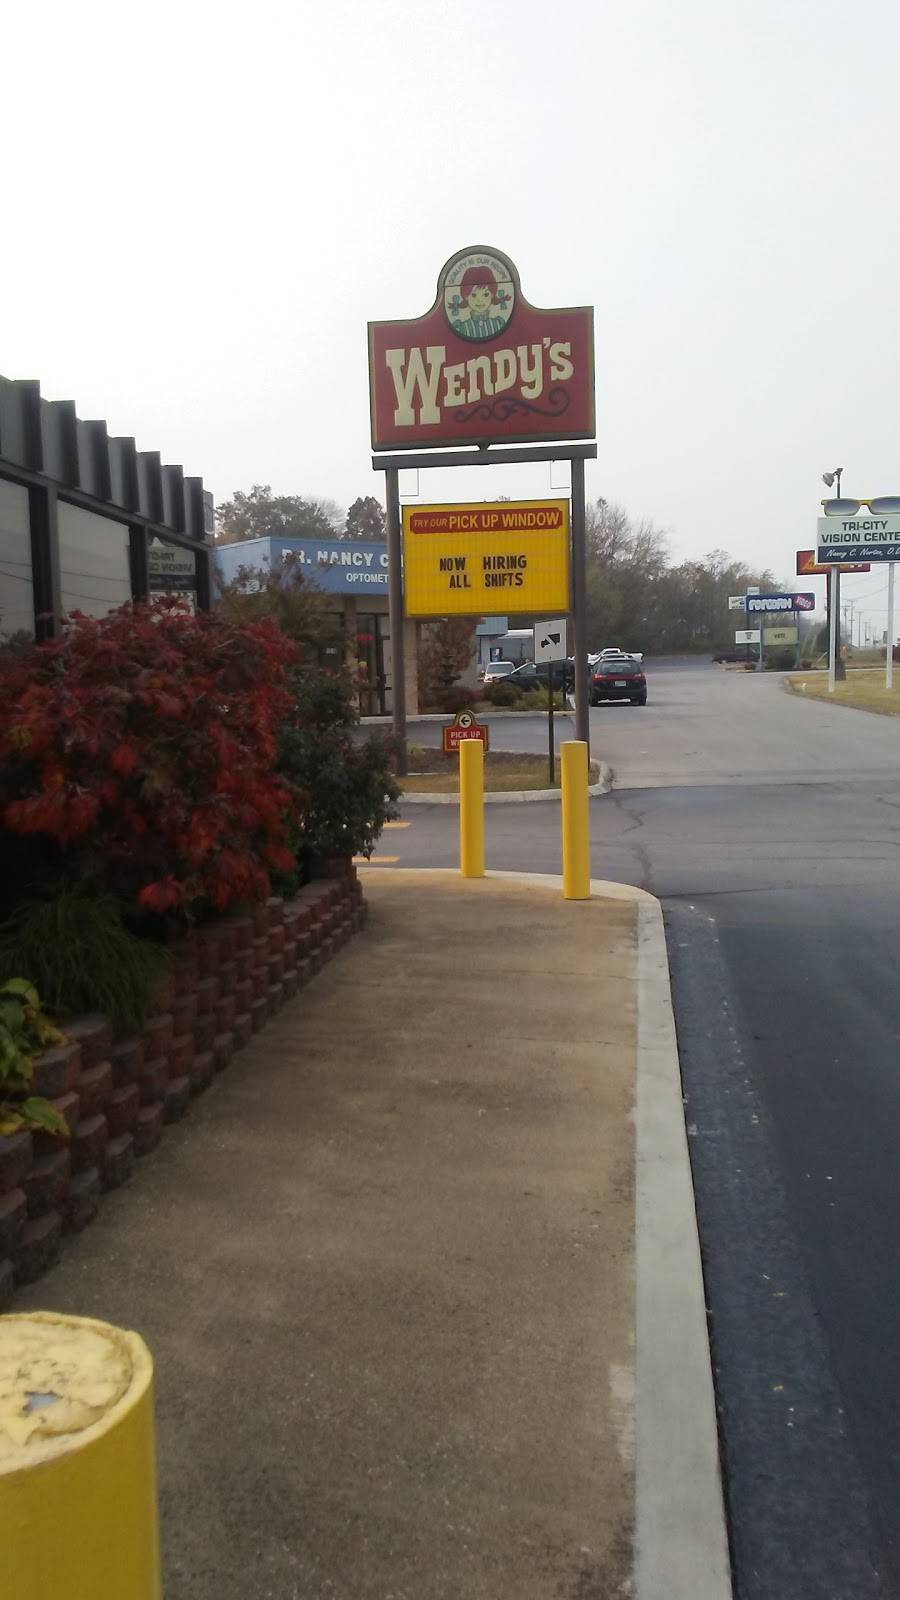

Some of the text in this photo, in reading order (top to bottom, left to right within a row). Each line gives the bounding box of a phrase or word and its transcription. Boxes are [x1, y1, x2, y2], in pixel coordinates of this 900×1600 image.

[385, 337, 574, 426] Wendy's
[413, 511, 560, 529] TRY OUR PICK UP WINDOW
[841, 520, 888, 531] TRI-CITY
[821, 533, 861, 544] VISION
[317, 550, 374, 567] NANCY
[826, 549, 848, 559] Nancy
[439, 554, 527, 572] NOW HIRING
[346, 572, 389, 584] OPTOMET
[449, 572, 524, 589] ALL SHIFTS
[450, 730, 481, 739] PICK UP
